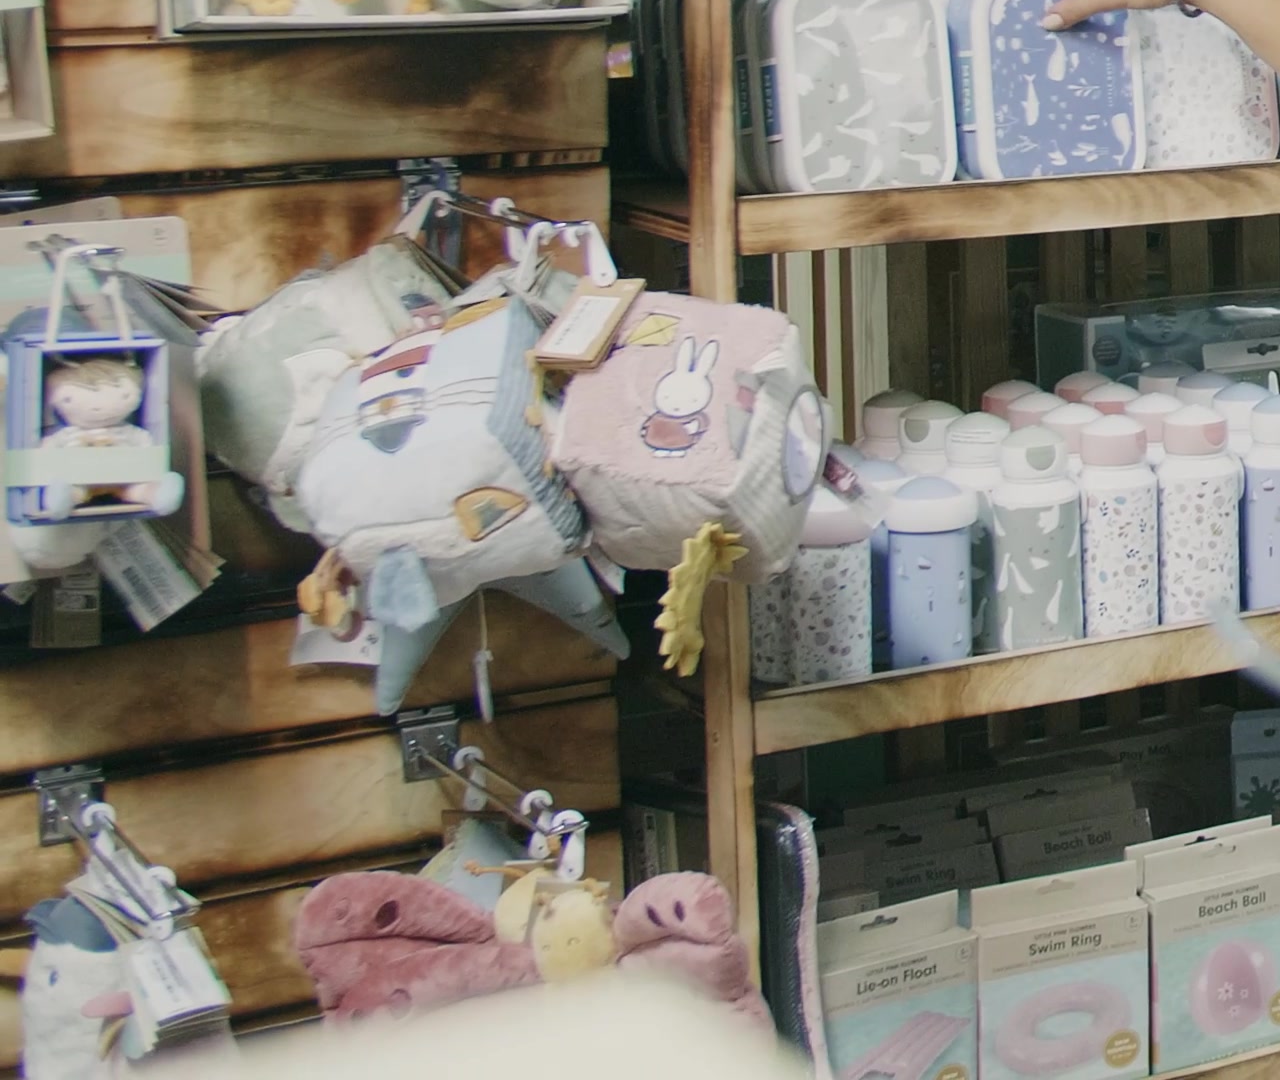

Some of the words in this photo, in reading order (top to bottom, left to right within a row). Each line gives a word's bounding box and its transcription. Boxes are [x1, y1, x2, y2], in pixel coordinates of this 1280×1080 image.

[762, 73, 775, 125] MEPAL
[960, 63, 973, 115] MEPAL
[1043, 837, 1084, 855] Beach
[1198, 898, 1238, 918] Beach
[1242, 891, 1266, 908] Ball
[1028, 938, 1066, 956] Swim
[1070, 932, 1102, 948] Ring
[856, 974, 899, 995] Lie-on
[903, 963, 938, 983] Float
